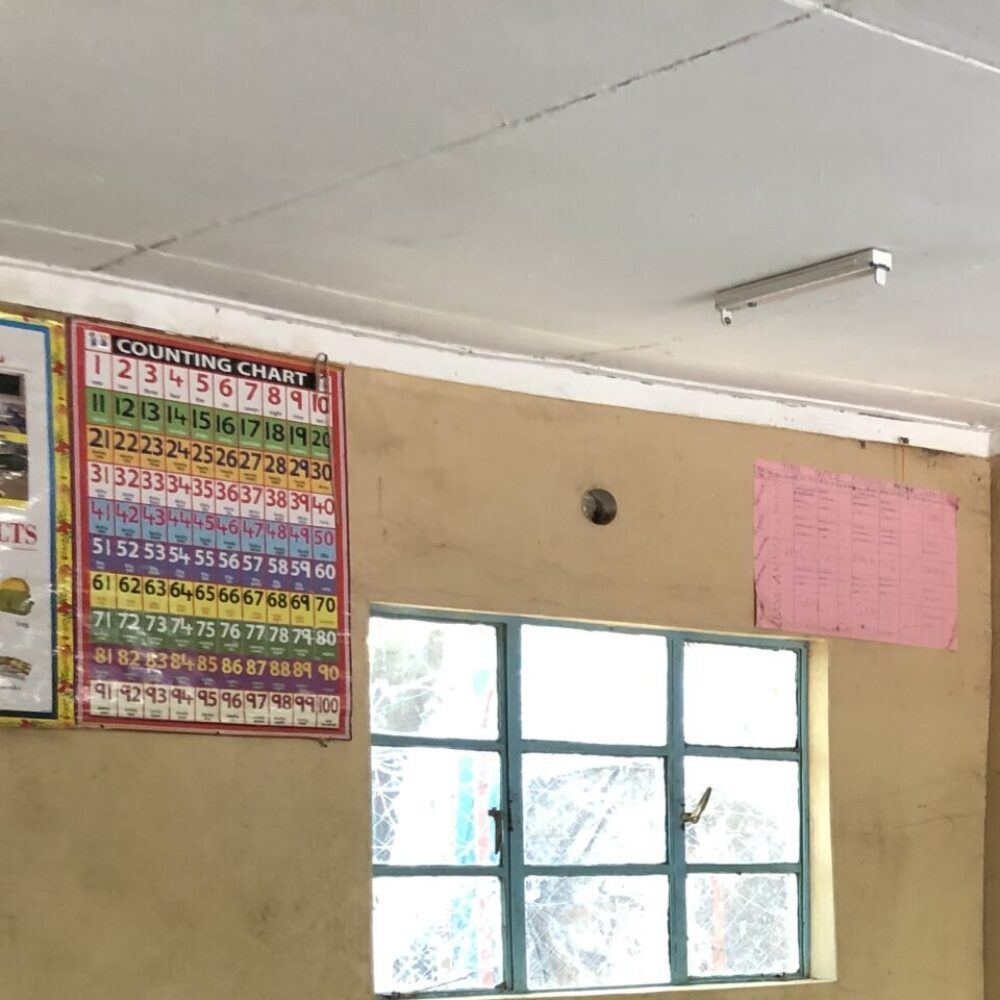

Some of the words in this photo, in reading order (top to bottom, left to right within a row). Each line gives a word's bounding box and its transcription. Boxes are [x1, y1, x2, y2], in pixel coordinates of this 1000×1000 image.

[95, 354, 100, 374] 1
[118, 359, 132, 379] 2
[144, 364, 158, 383] 3
[169, 368, 183, 387] 4
[196, 374, 209, 392] 5
[219, 378, 232, 397] 6
[244, 382, 258, 400] 7
[268, 386, 281, 405] 8
[291, 391, 302, 410] 9
[313, 394, 329, 414] 10
[117, 339, 232, 372] COUNTING
[237, 361, 308, 386] CHART
[93, 393, 105, 413] 11
[116, 397, 135, 418] 12
[142, 401, 160, 421] 13
[168, 405, 187, 425] 14
[193, 409, 211, 429] 15
[216, 415, 235, 435] 16
[241, 418, 260, 437] 17
[266, 421, 285, 442] 18
[290, 426, 307, 446] 19
[312, 430, 330, 448] 20
[89, 428, 109, 448] 21
[114, 431, 138, 452] 22
[141, 435, 163, 456] 23
[167, 439, 189, 458] 24
[192, 443, 213, 463] 25
[216, 448, 238, 468] 26
[240, 451, 261, 471] 27
[265, 455, 286, 475] 28
[290, 459, 309, 478] 29
[311, 461, 332, 481] 30
[91, 464, 108, 484] 31
[115, 467, 139, 488] 32
[142, 471, 164, 491] 33
[167, 474, 191, 495] 34
[193, 478, 213, 498] 35
[216, 482, 238, 501] 36
[241, 485, 262, 504] 37
[267, 489, 286, 508] 38
[291, 492, 309, 512] 39
[313, 496, 335, 515] 40
[91, 501, 109, 521] 41
[116, 503, 138, 523] 42
[143, 507, 165, 525] 43
[169, 510, 191, 528] 44
[193, 513, 215, 530] 45
[217, 518, 238, 536] 46
[243, 520, 263, 538] 47
[267, 524, 286, 539] 48
[290, 526, 309, 544] 49
[314, 530, 333, 546] 50
[92, 537, 110, 556] 51
[117, 541, 139, 558] 52
[144, 543, 166, 560] 53
[169, 546, 190, 565] 54
[195, 550, 214, 567] 55
[218, 551, 239, 569] 56
[242, 555, 262, 572] 57
[268, 558, 288, 574] 58
[290, 561, 311, 578] 59
[315, 564, 336, 580] 60
[92, 575, 110, 590] 61
[119, 577, 140, 593] 62
[145, 580, 166, 596] 63
[170, 582, 193, 601] 64
[196, 585, 215, 601] 65
[219, 587, 240, 603] 66
[243, 590, 263, 606] 67
[267, 592, 287, 608] 68
[291, 595, 309, 611] 69
[315, 597, 335, 612] 70
[93, 611, 110, 627] 71
[118, 613, 140, 629] 72
[146, 615, 167, 632] 73
[171, 618, 193, 635] 74
[197, 621, 215, 638] 75
[220, 622, 240, 639] 76
[245, 624, 265, 640] 77
[269, 627, 289, 643] 78
[293, 629, 311, 645] 79
[316, 630, 336, 646] 80
[95, 647, 112, 664] 81
[118, 649, 140, 666] 82
[145, 652, 168, 669] 83
[170, 653, 195, 671] 84
[197, 656, 217, 672] 85
[222, 657, 243, 674] 86
[246, 659, 266, 675] 87
[270, 661, 291, 677] 88
[293, 662, 312, 679] 89
[318, 664, 339, 680] 90
[95, 683, 111, 699] 91
[120, 685, 140, 702] 92
[146, 687, 167, 703] 93
[171, 688, 193, 704] 94
[198, 690, 217, 706] 95
[222, 692, 242, 708] 96
[247, 693, 267, 709] 97
[271, 694, 292, 709] 98
[295, 696, 315, 712] 99
[318, 697, 338, 713] 100
